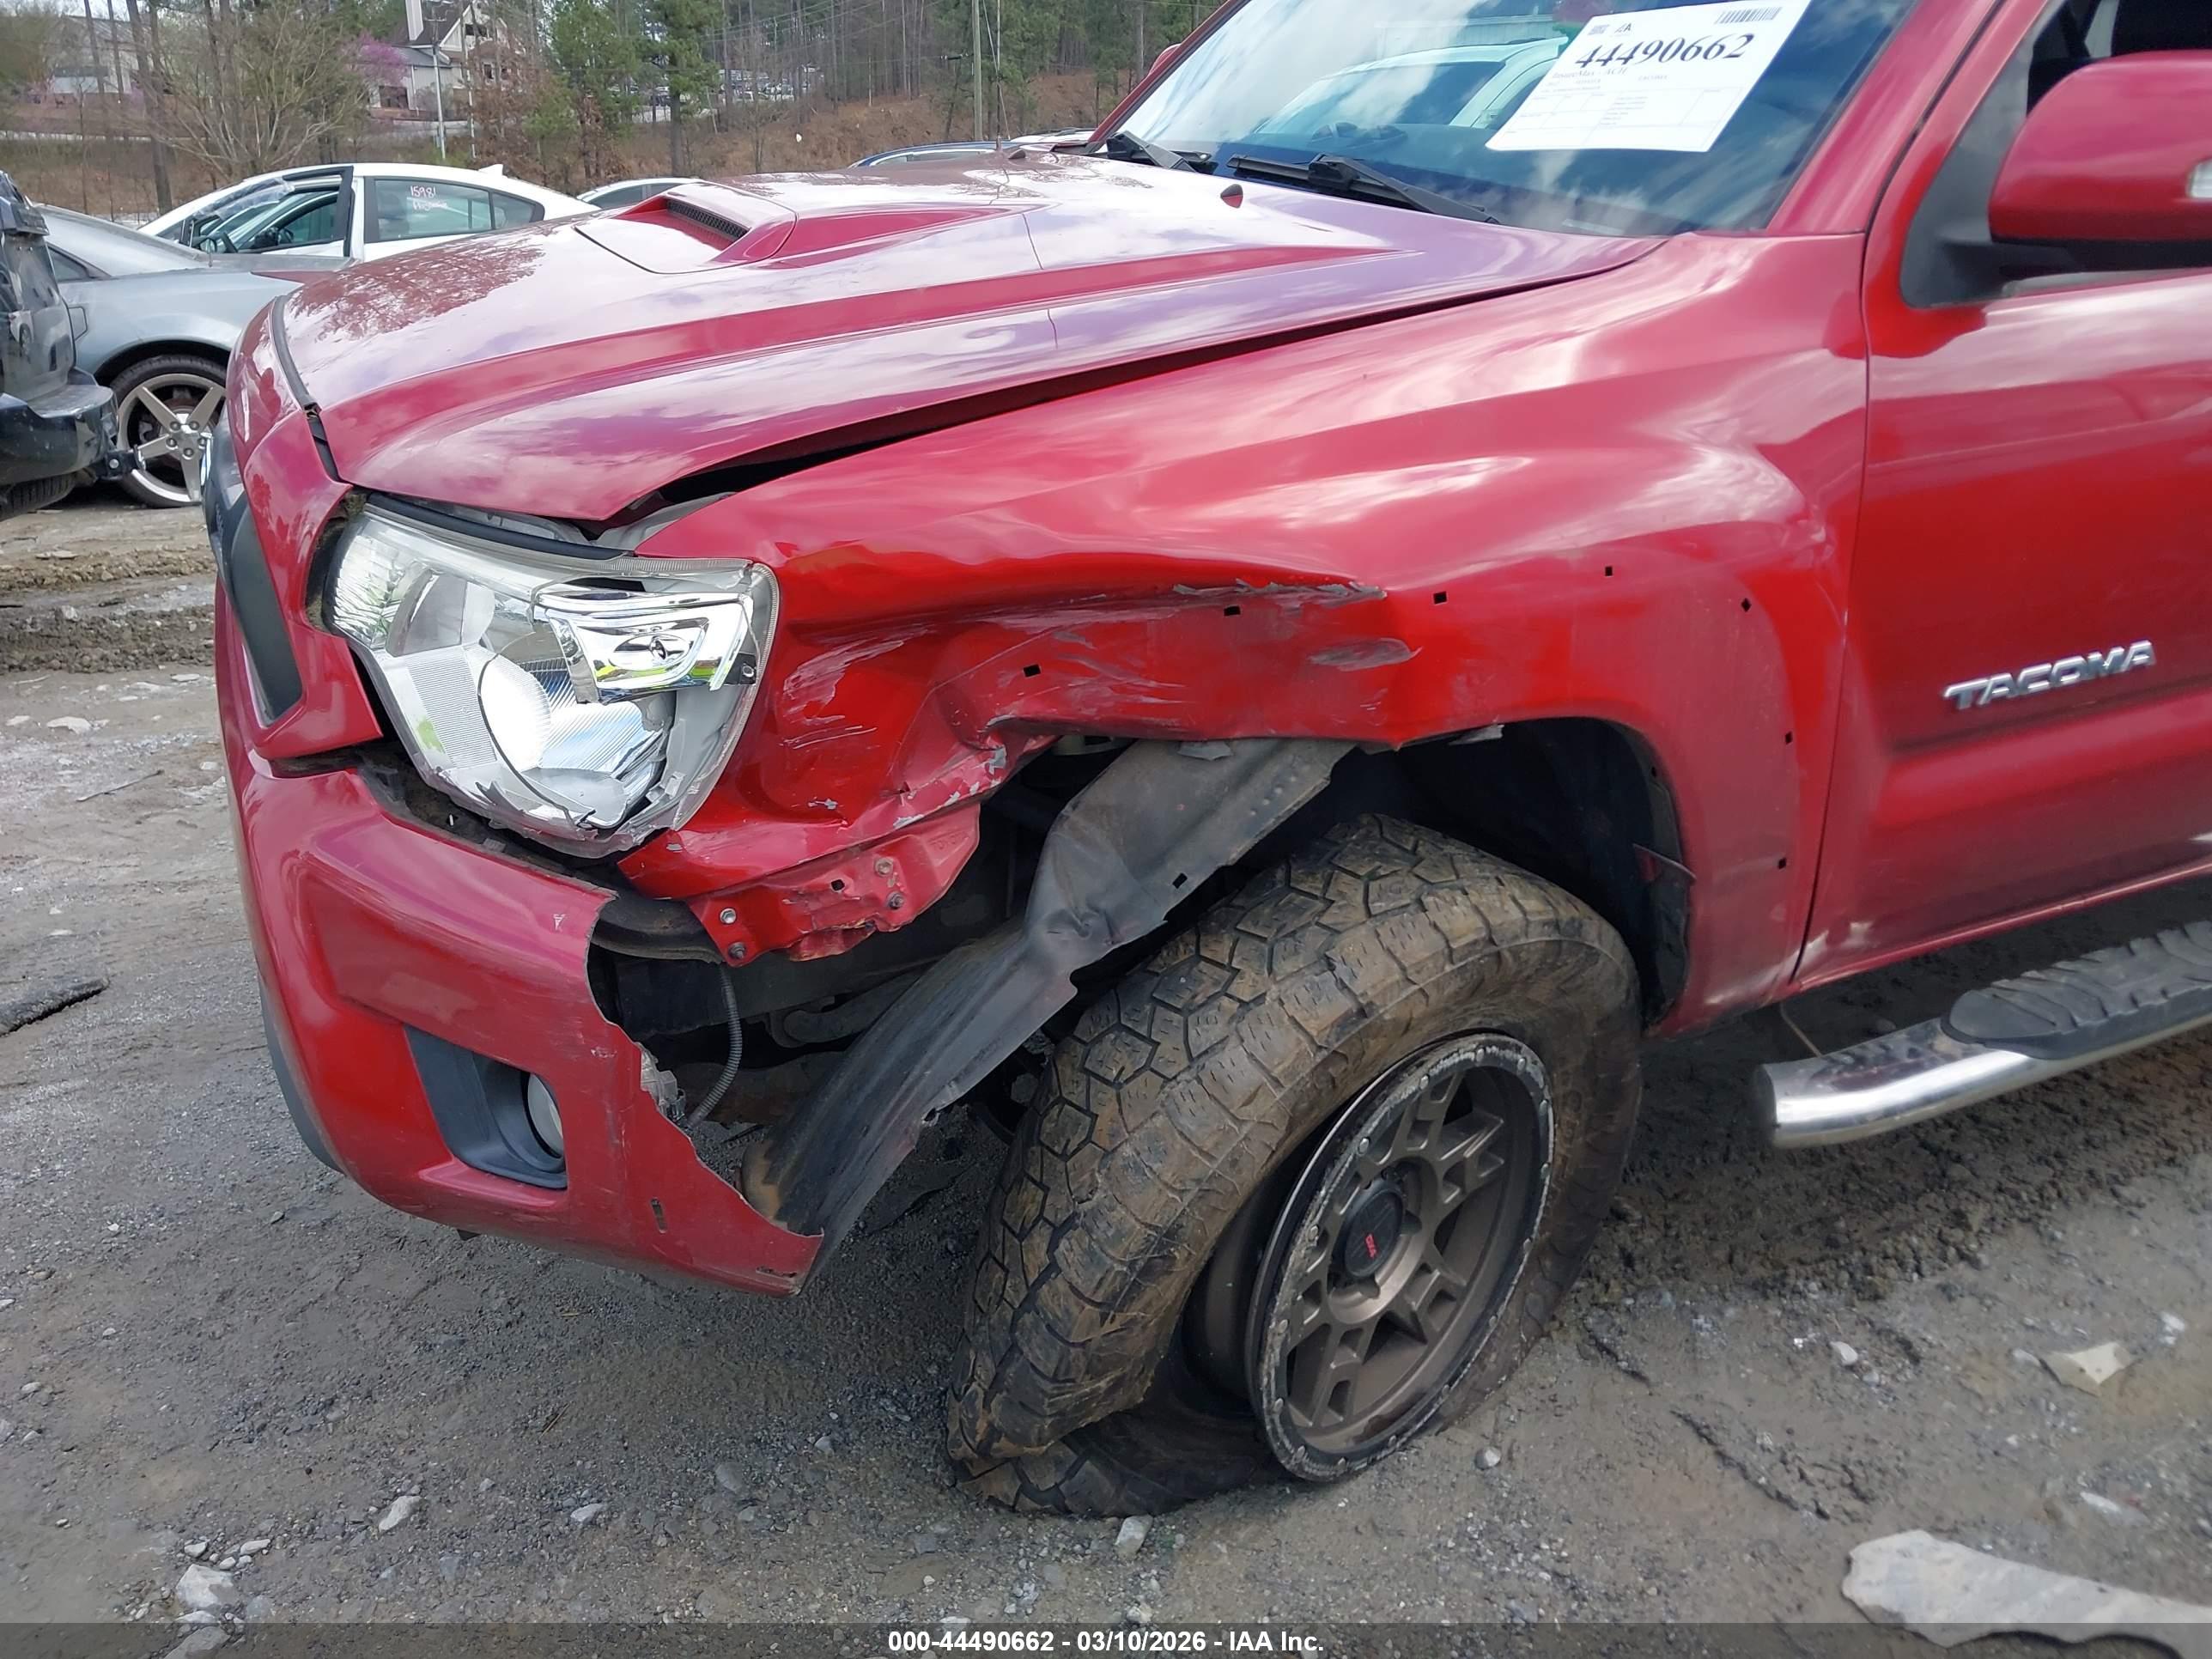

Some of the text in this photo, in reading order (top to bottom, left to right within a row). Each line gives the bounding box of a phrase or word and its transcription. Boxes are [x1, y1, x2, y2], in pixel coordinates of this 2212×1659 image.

[1575, 33, 1755, 69] 44490662
[410, 185, 437, 198] 15981
[1942, 639, 2157, 711] TACOMA
